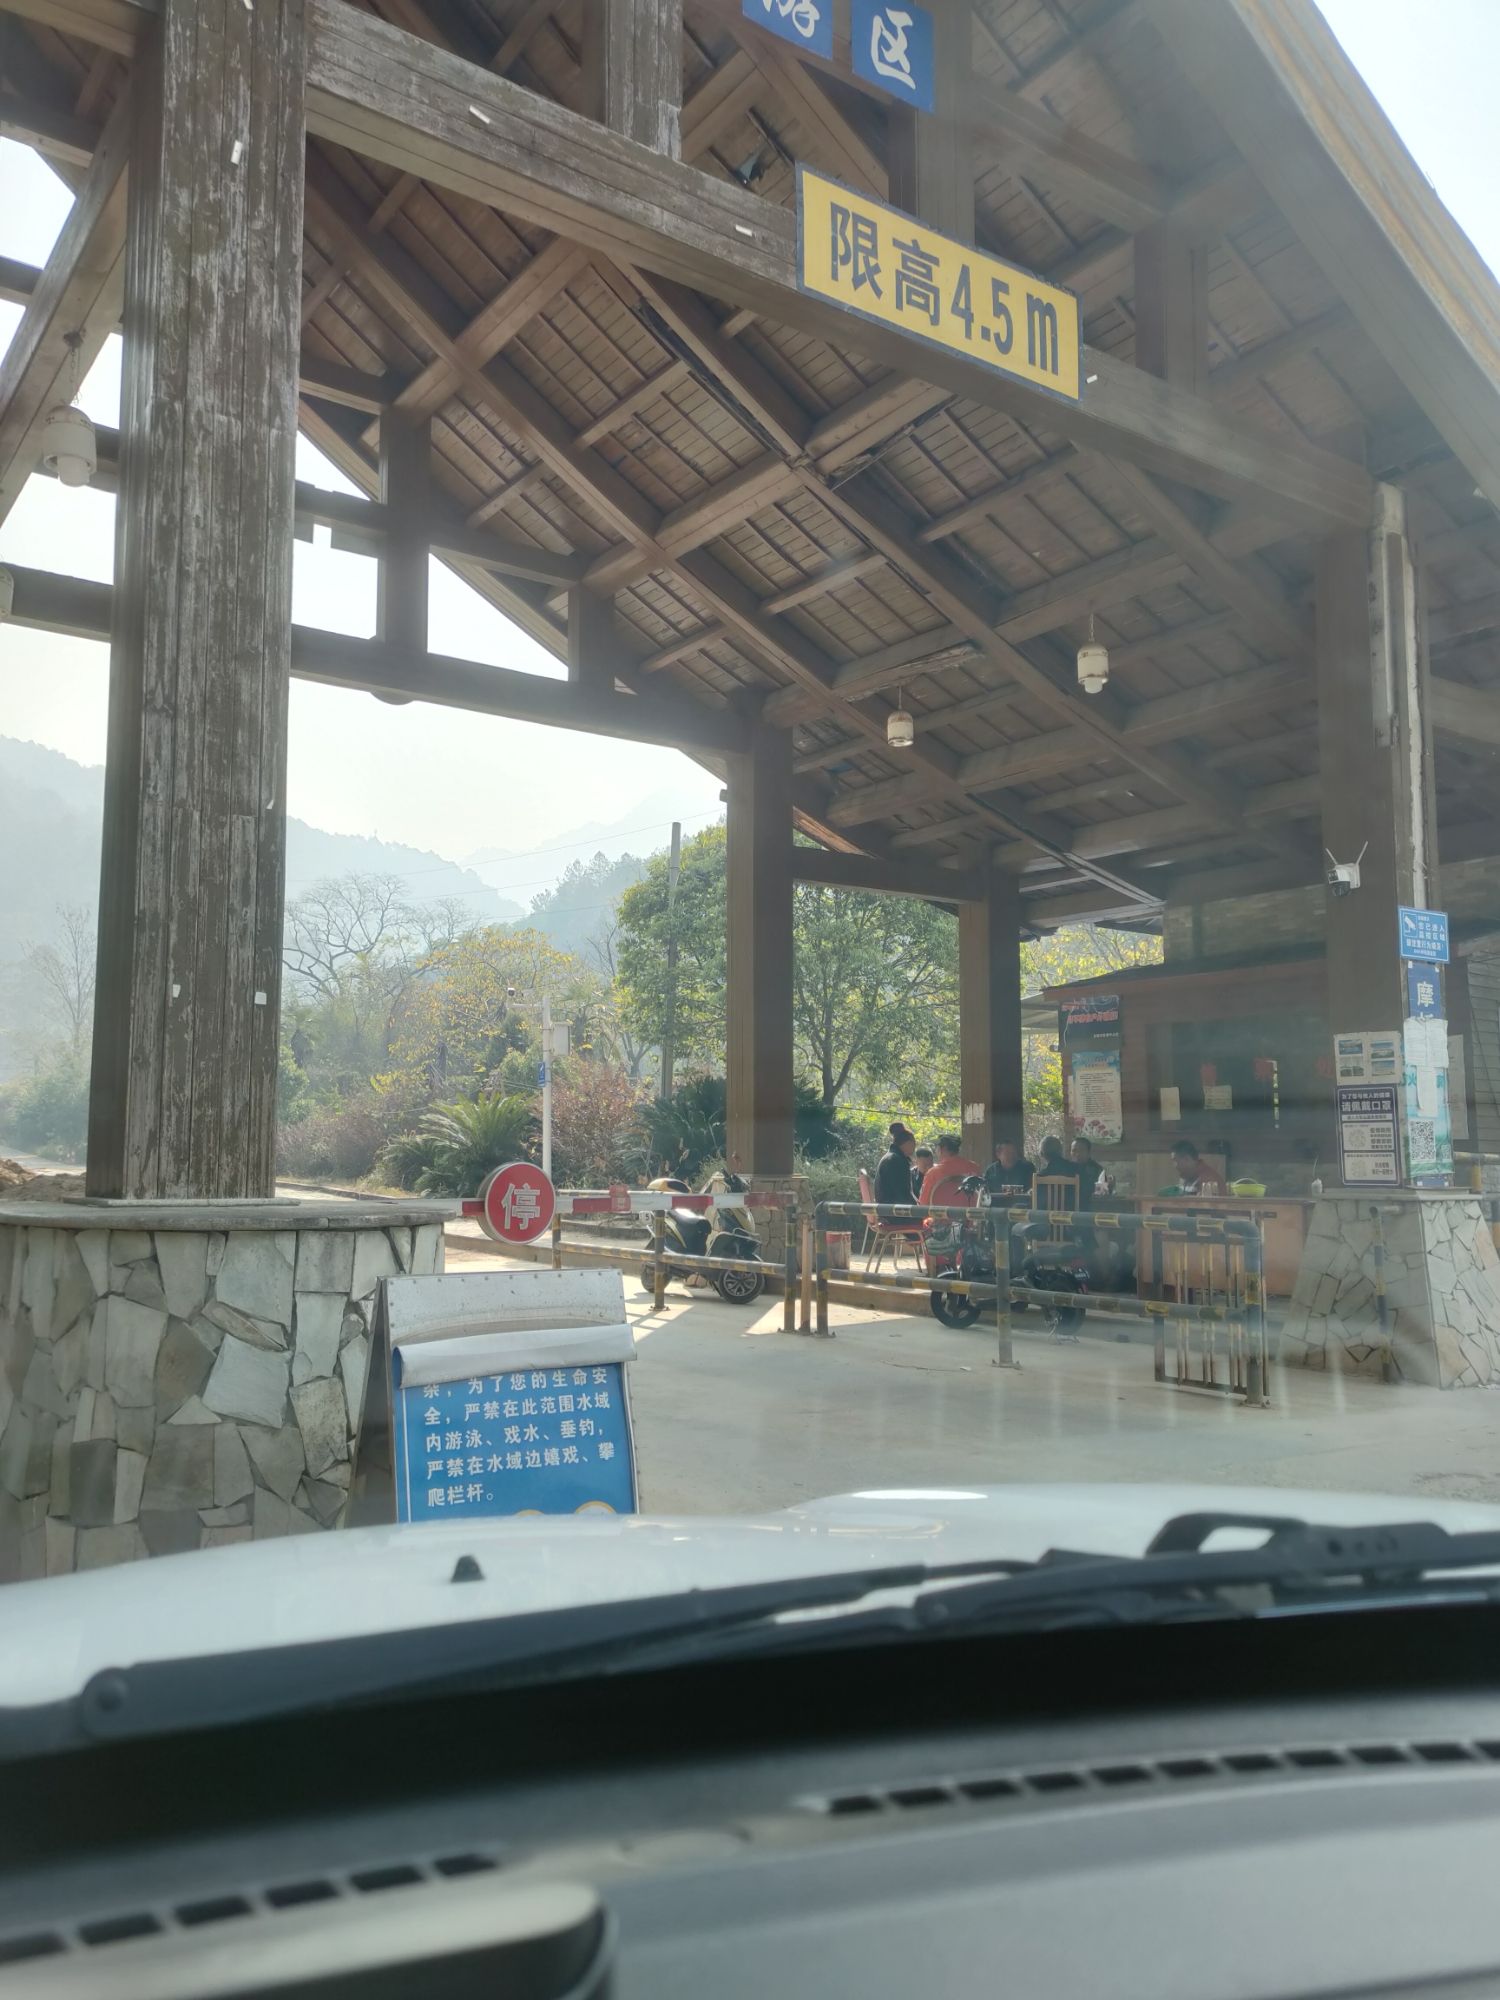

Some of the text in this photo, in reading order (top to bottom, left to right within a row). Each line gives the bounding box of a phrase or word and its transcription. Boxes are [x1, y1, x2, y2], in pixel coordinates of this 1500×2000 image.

[829, 201, 1060, 377] 限高4.5m
[1341, 1101, 1392, 1112] 请佩戴口罩
[501, 1183, 541, 1231] 停
[424, 1392, 611, 1426] 全，严禁在此范围水域
[426, 1418, 604, 1453] 内游泳、戏水、垂钓，
[427, 1441, 615, 1480] 严禁在水域边嬉戏、攀
[427, 1483, 494, 1507] 爬栏杆。
